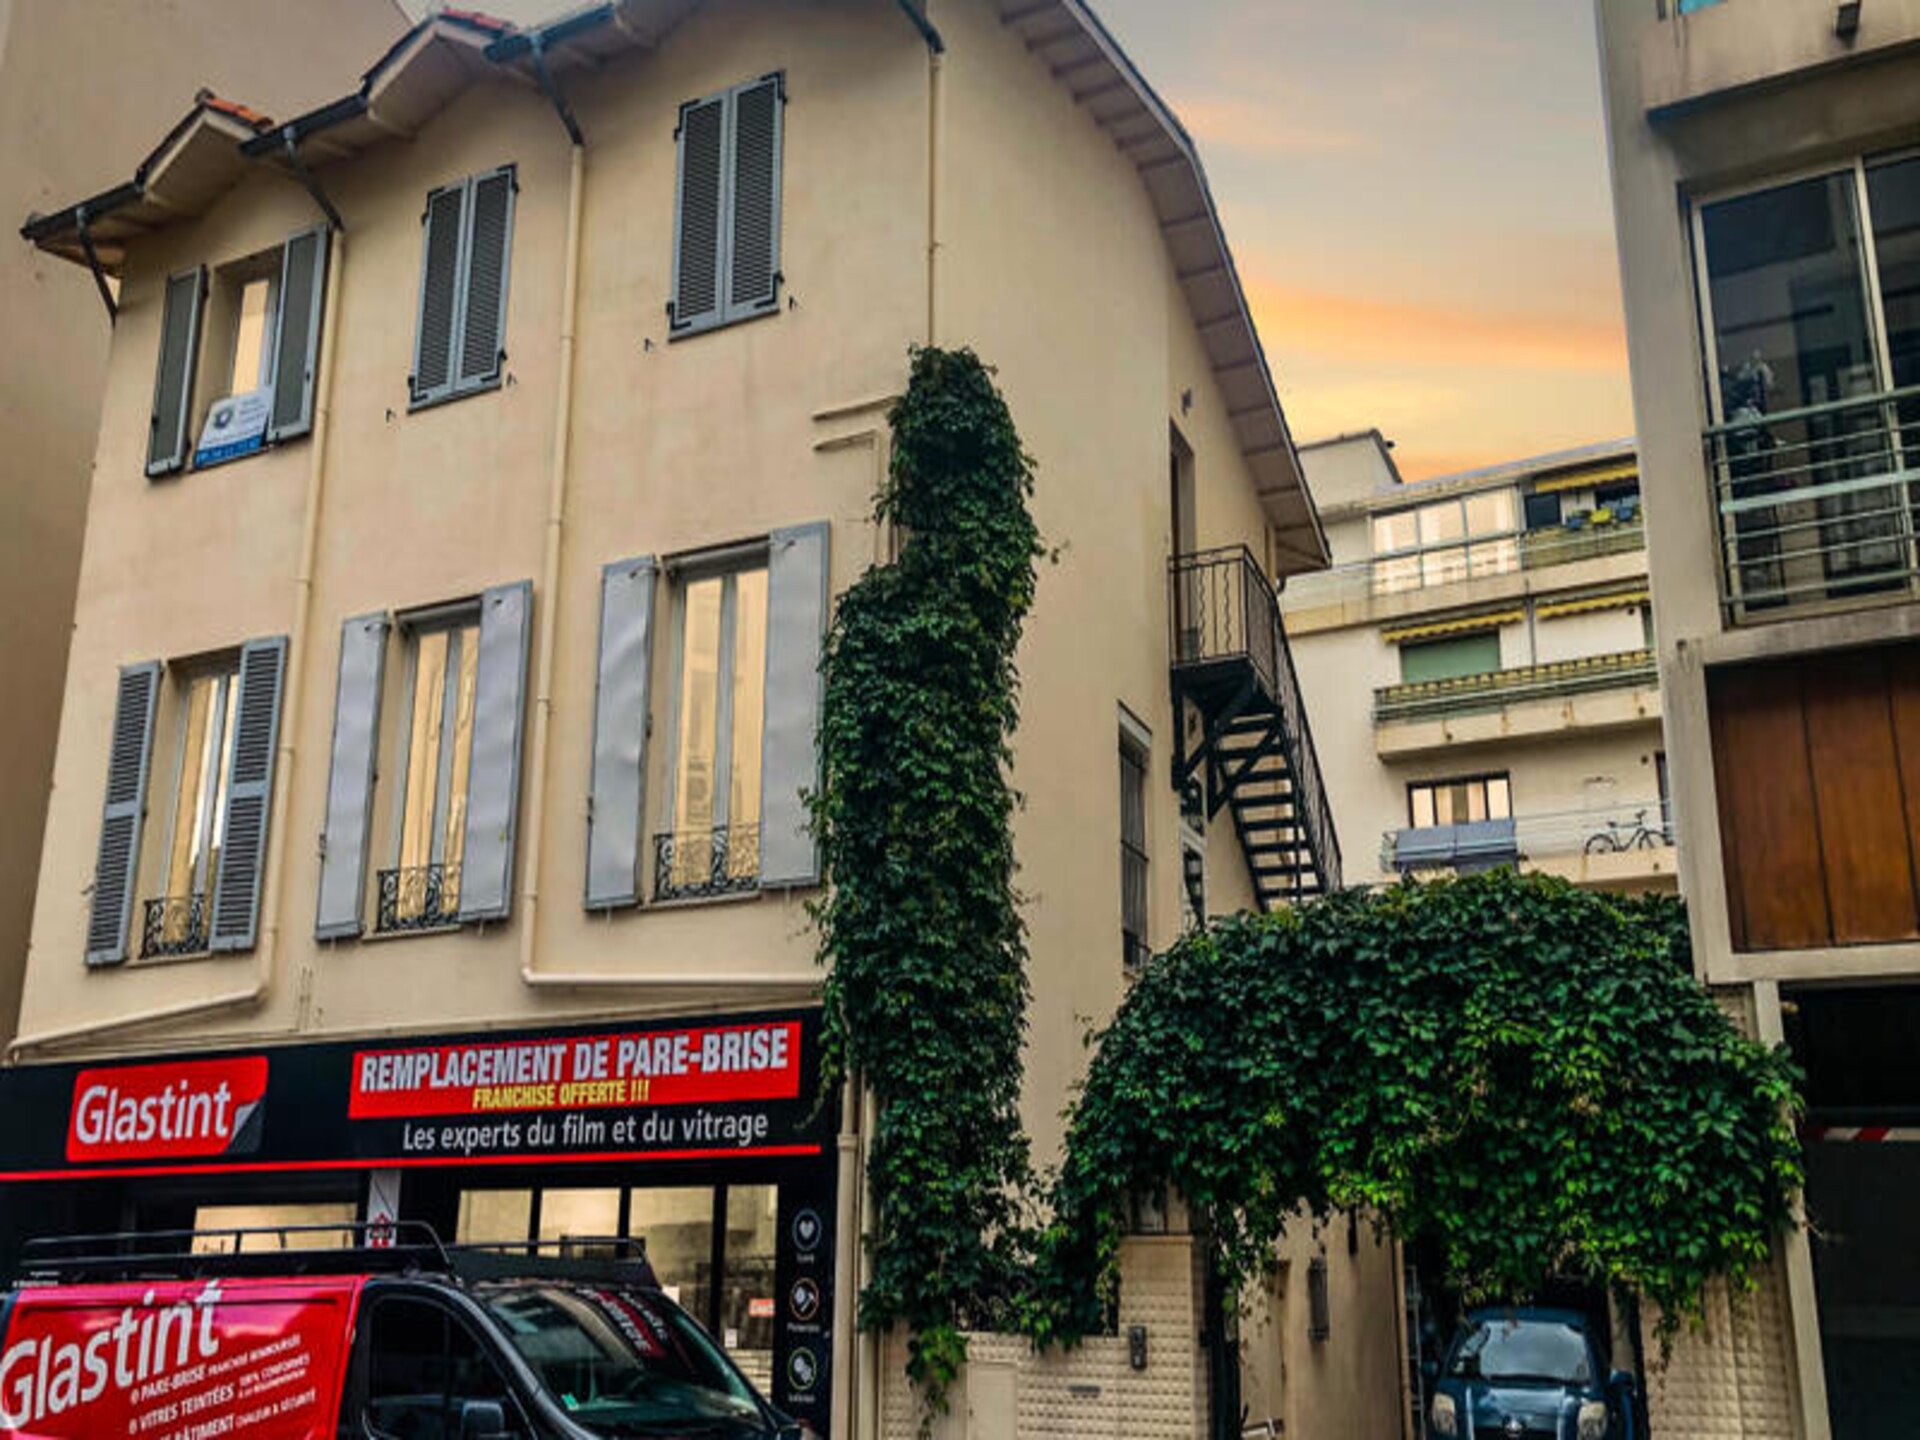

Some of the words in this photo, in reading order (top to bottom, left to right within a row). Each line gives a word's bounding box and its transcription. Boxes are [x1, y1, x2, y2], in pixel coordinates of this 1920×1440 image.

[361, 1043, 567, 1092] REMPLACEMENT
[573, 1040, 609, 1081] DE
[616, 1028, 788, 1078] PARE-BRISE
[76, 1079, 231, 1145] Glastint
[472, 1085, 555, 1110] FRANCHISE
[559, 1080, 625, 1105] OFFERTE
[403, 1122, 435, 1150] Les
[441, 1121, 521, 1155] experts
[527, 1115, 555, 1146] du
[561, 1111, 606, 1145] film
[611, 1114, 637, 1143] et
[642, 1110, 674, 1142] du
[681, 1109, 769, 1147] vitrage
[0, 1278, 222, 1430] Glastint
[139, 1402, 179, 1431] VITRES
